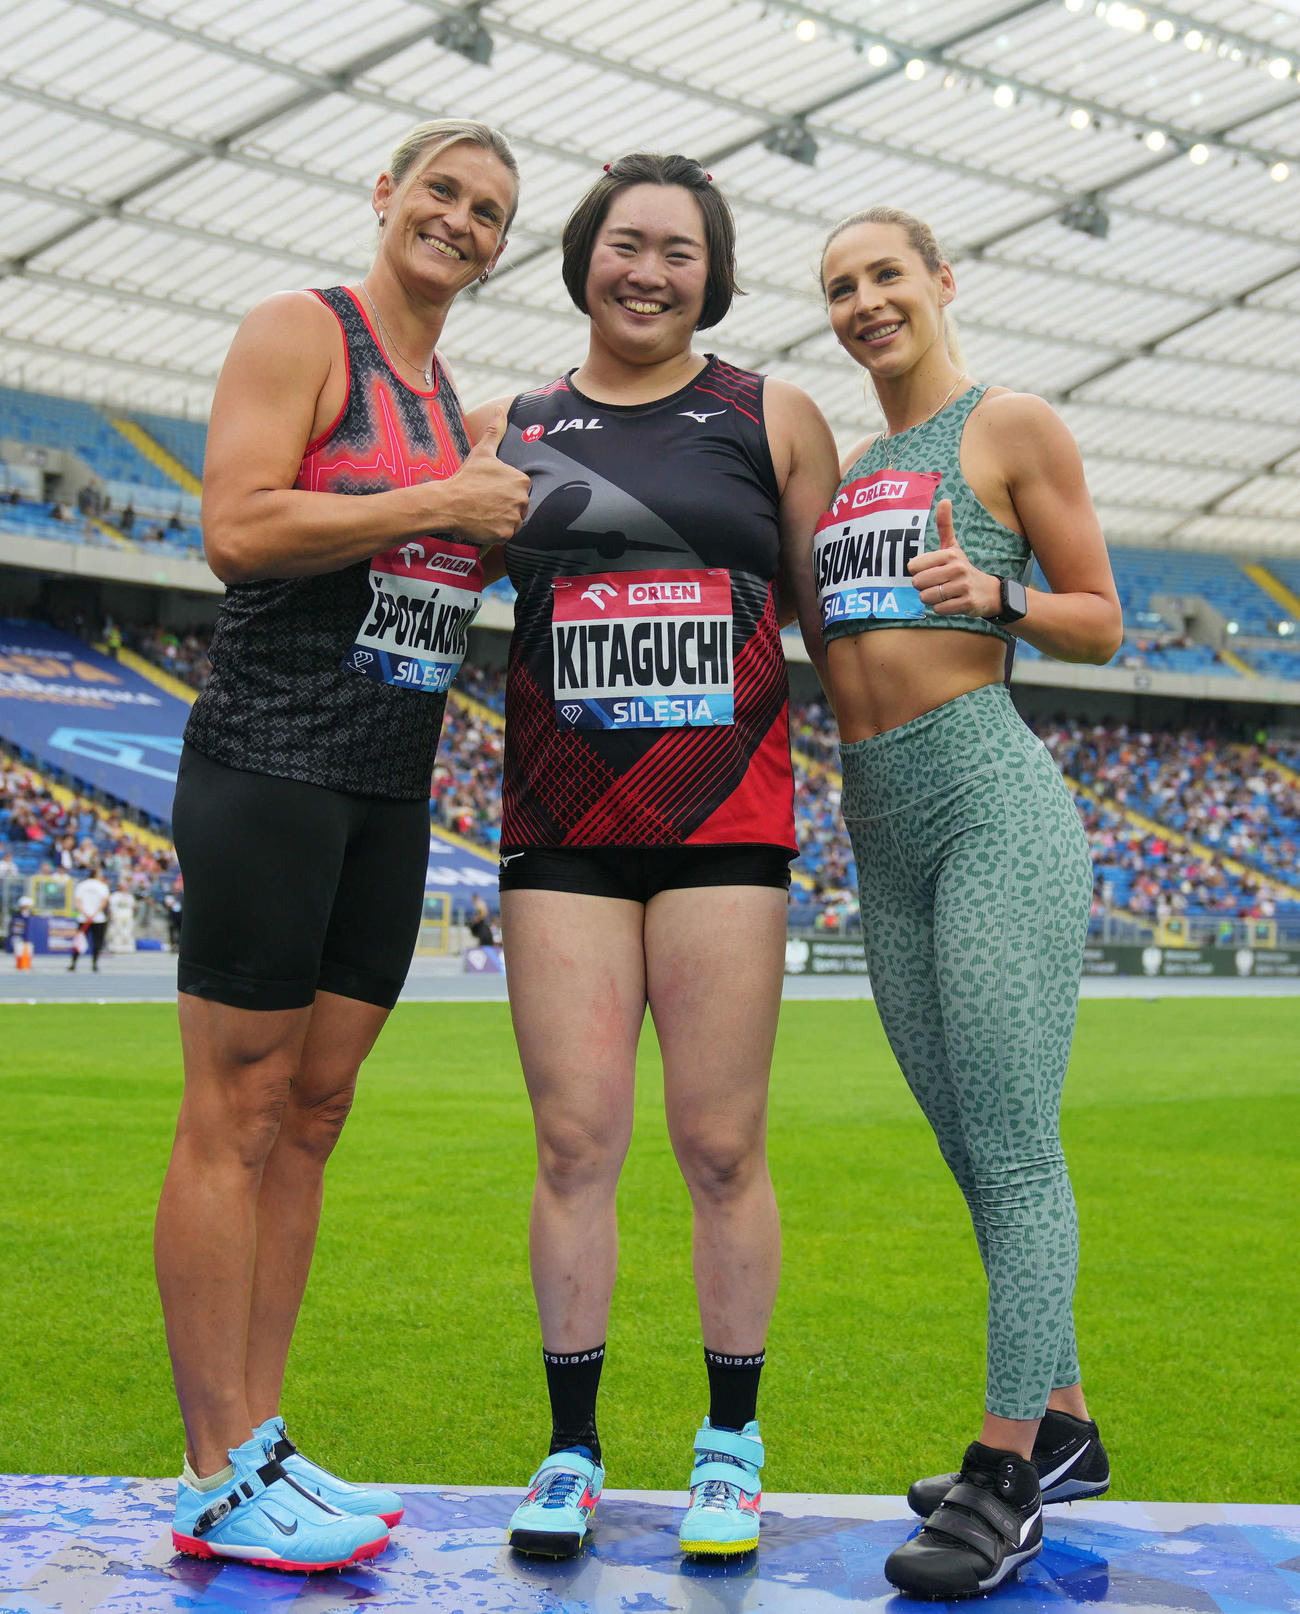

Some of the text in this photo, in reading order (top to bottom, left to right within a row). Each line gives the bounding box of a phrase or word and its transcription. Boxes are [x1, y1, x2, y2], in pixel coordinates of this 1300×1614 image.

[546, 418, 603, 436] JAL
[856, 483, 903, 504] ORLEN
[431, 555, 473, 573] ORLEN
[632, 585, 696, 602] ORLEN
[824, 591, 899, 620] SILESIA
[556, 621, 729, 689] KITAGUCHI
[393, 661, 451, 687] SILESIA
[613, 700, 712, 723] SILESIA
